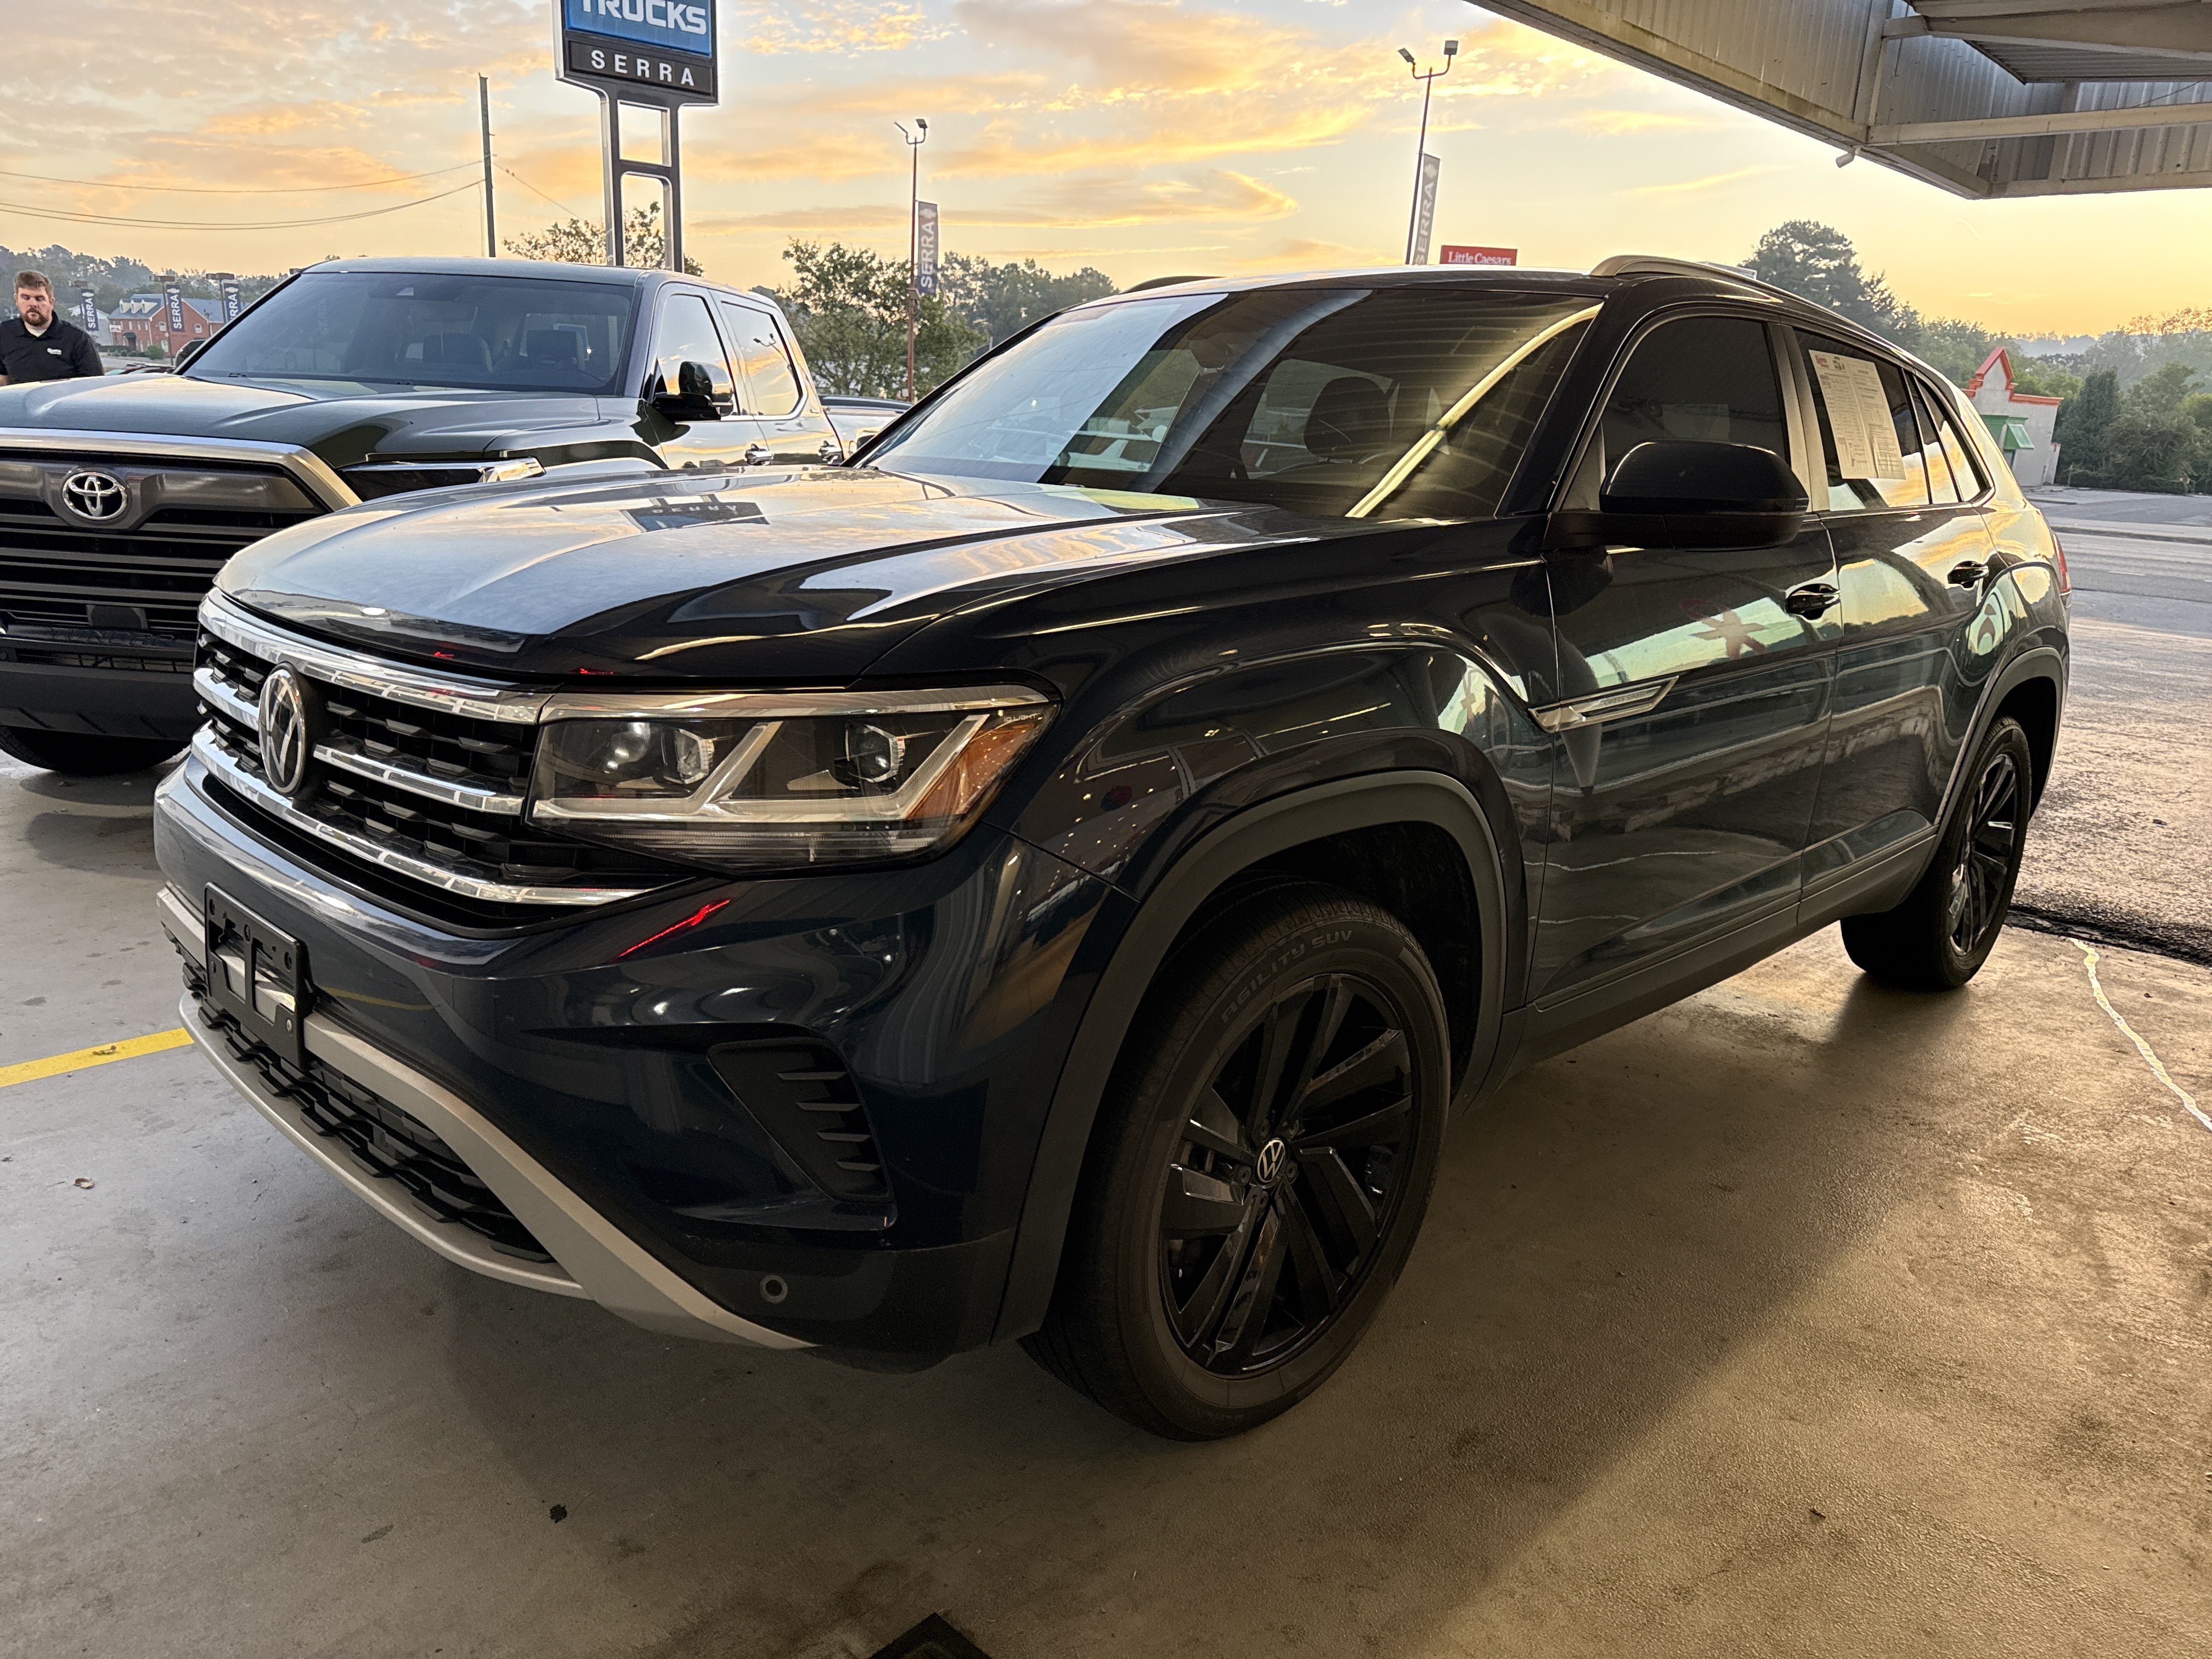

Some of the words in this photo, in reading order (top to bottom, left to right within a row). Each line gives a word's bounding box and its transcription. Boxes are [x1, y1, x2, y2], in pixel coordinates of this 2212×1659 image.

[591, 49, 695, 87] SERRA
[1415, 181, 1434, 265] SERRA
[920, 221, 935, 289] SERRA
[1448, 251, 1474, 264] Little
[1474, 252, 1511, 266] Caesars
[85, 297, 96, 329] SERRA
[170, 294, 182, 329] SERRA
[228, 294, 239, 319] RRA
[1221, 943, 1306, 1024] AGILITY
[1312, 930, 1353, 950] SUV
